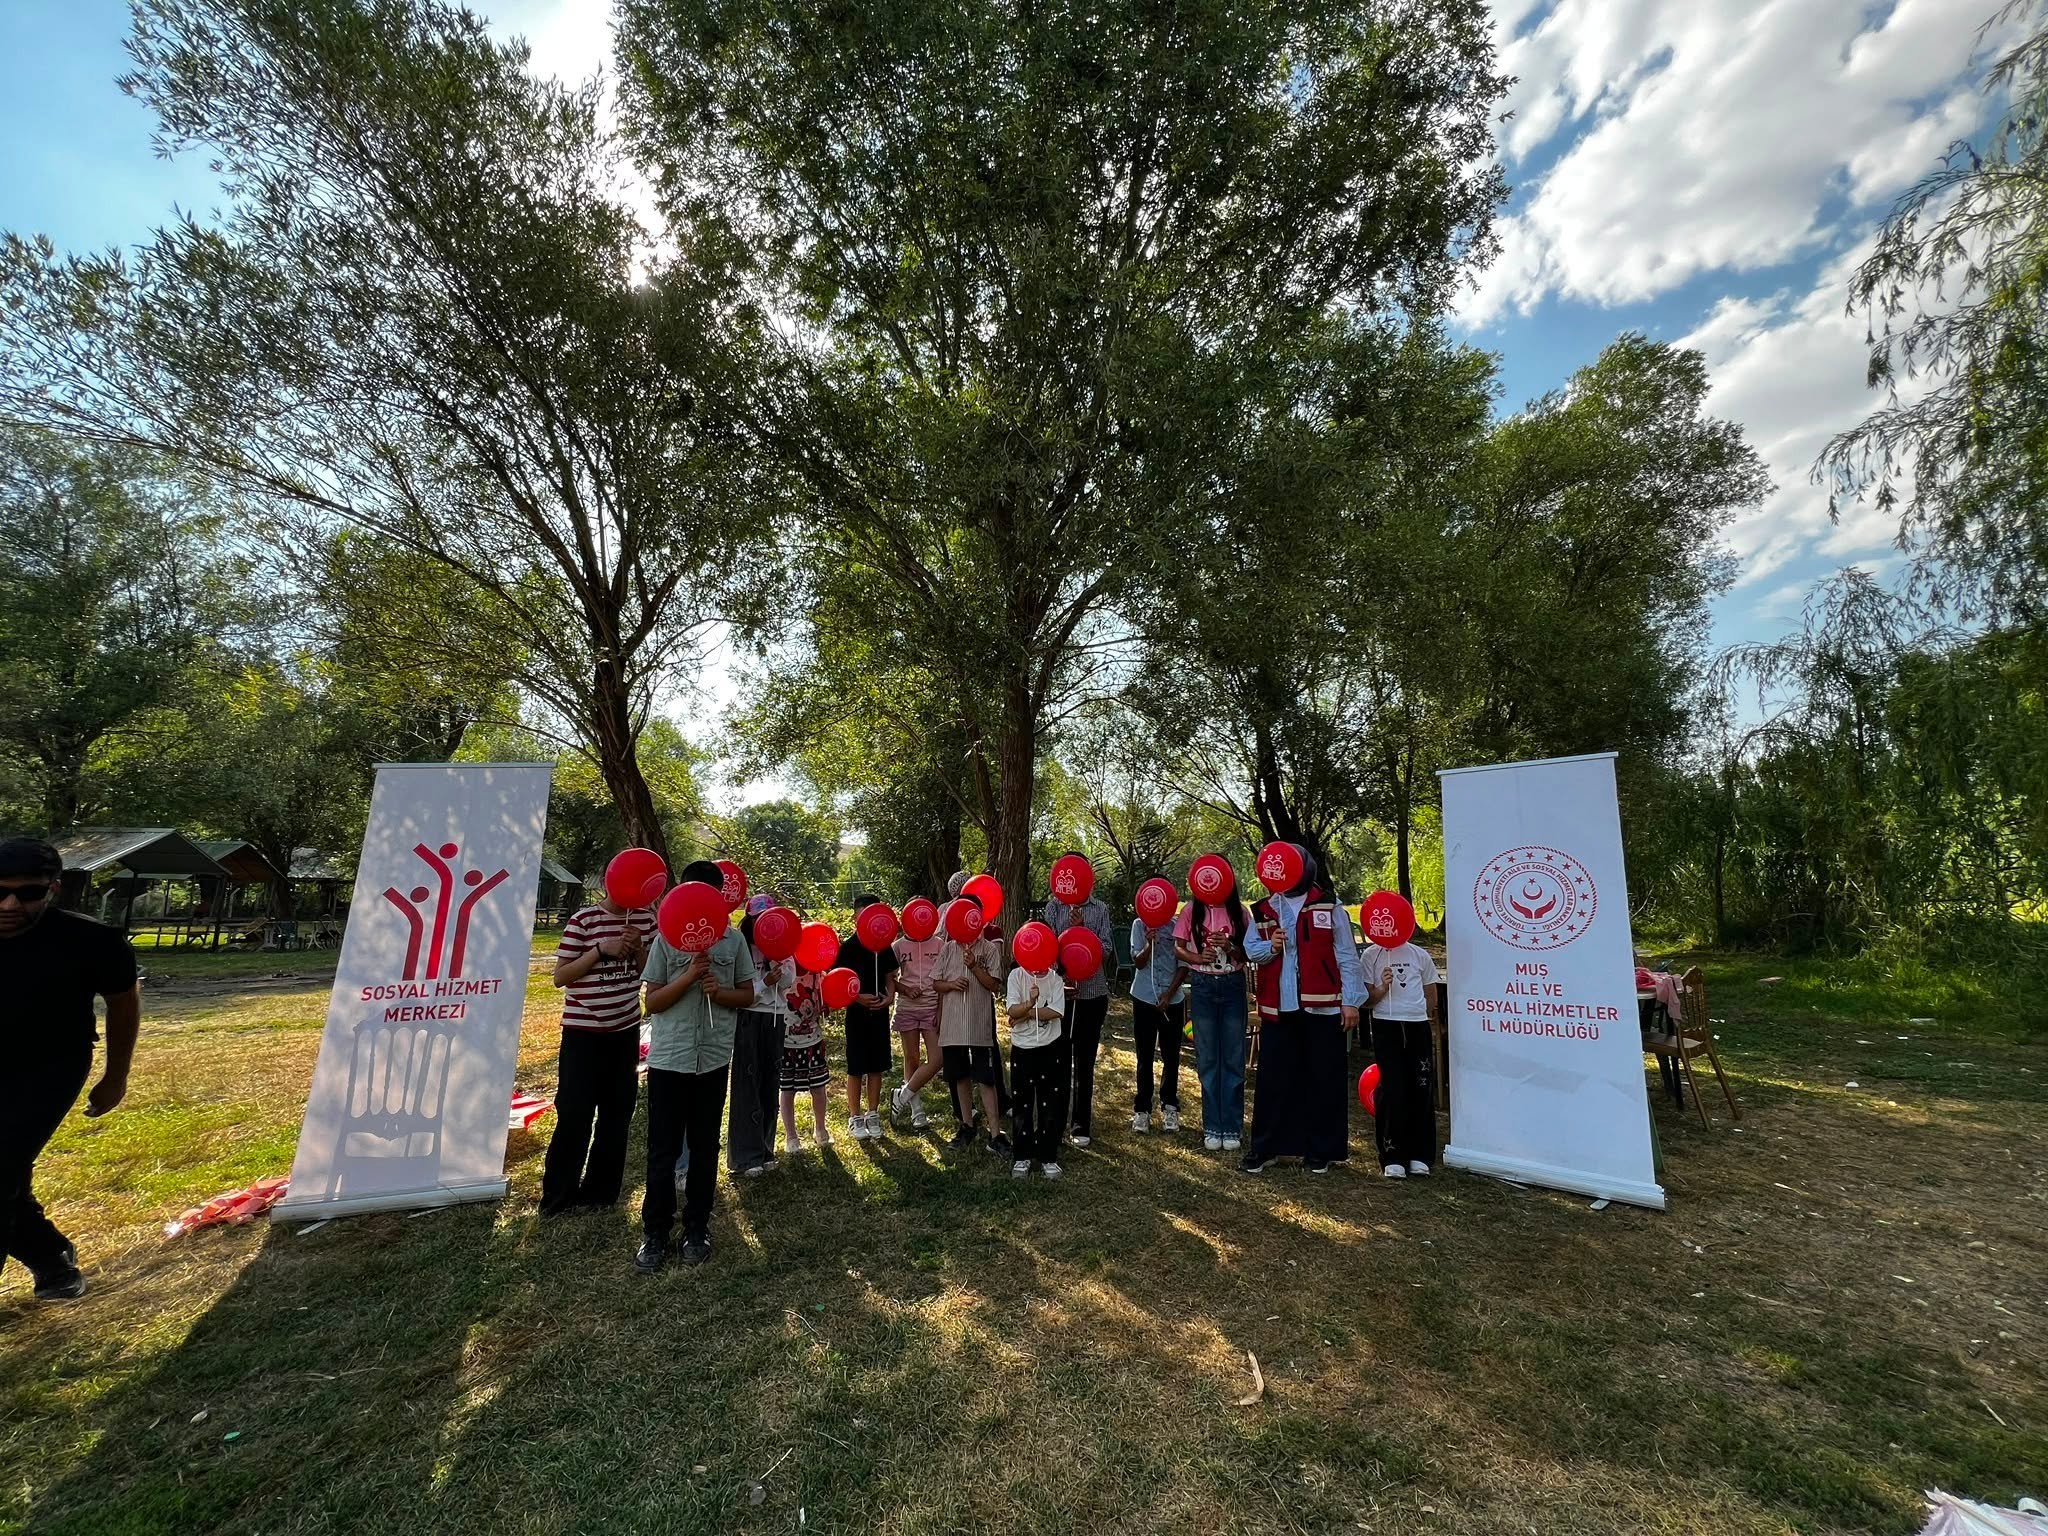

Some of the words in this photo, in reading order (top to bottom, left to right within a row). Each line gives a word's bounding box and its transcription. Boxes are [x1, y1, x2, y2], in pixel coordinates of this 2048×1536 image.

[1532, 864, 1556, 876] SOSYAL
[901, 952, 913, 962] 21
[1515, 963, 1549, 979] MUŞ
[361, 984, 429, 1001] SOSYAL
[435, 978, 502, 997] HİZMET
[1505, 979, 1539, 995] AİLE
[1542, 983, 1563, 996] VE
[384, 1000, 465, 1022] MERKEZİ
[1467, 999, 1522, 1014] SOSYAL
[1526, 1000, 1618, 1020] HİZMETLER
[1482, 1016, 1495, 1032] İL
[1500, 1018, 1599, 1040] MÜDÜRLÜĞÜ
